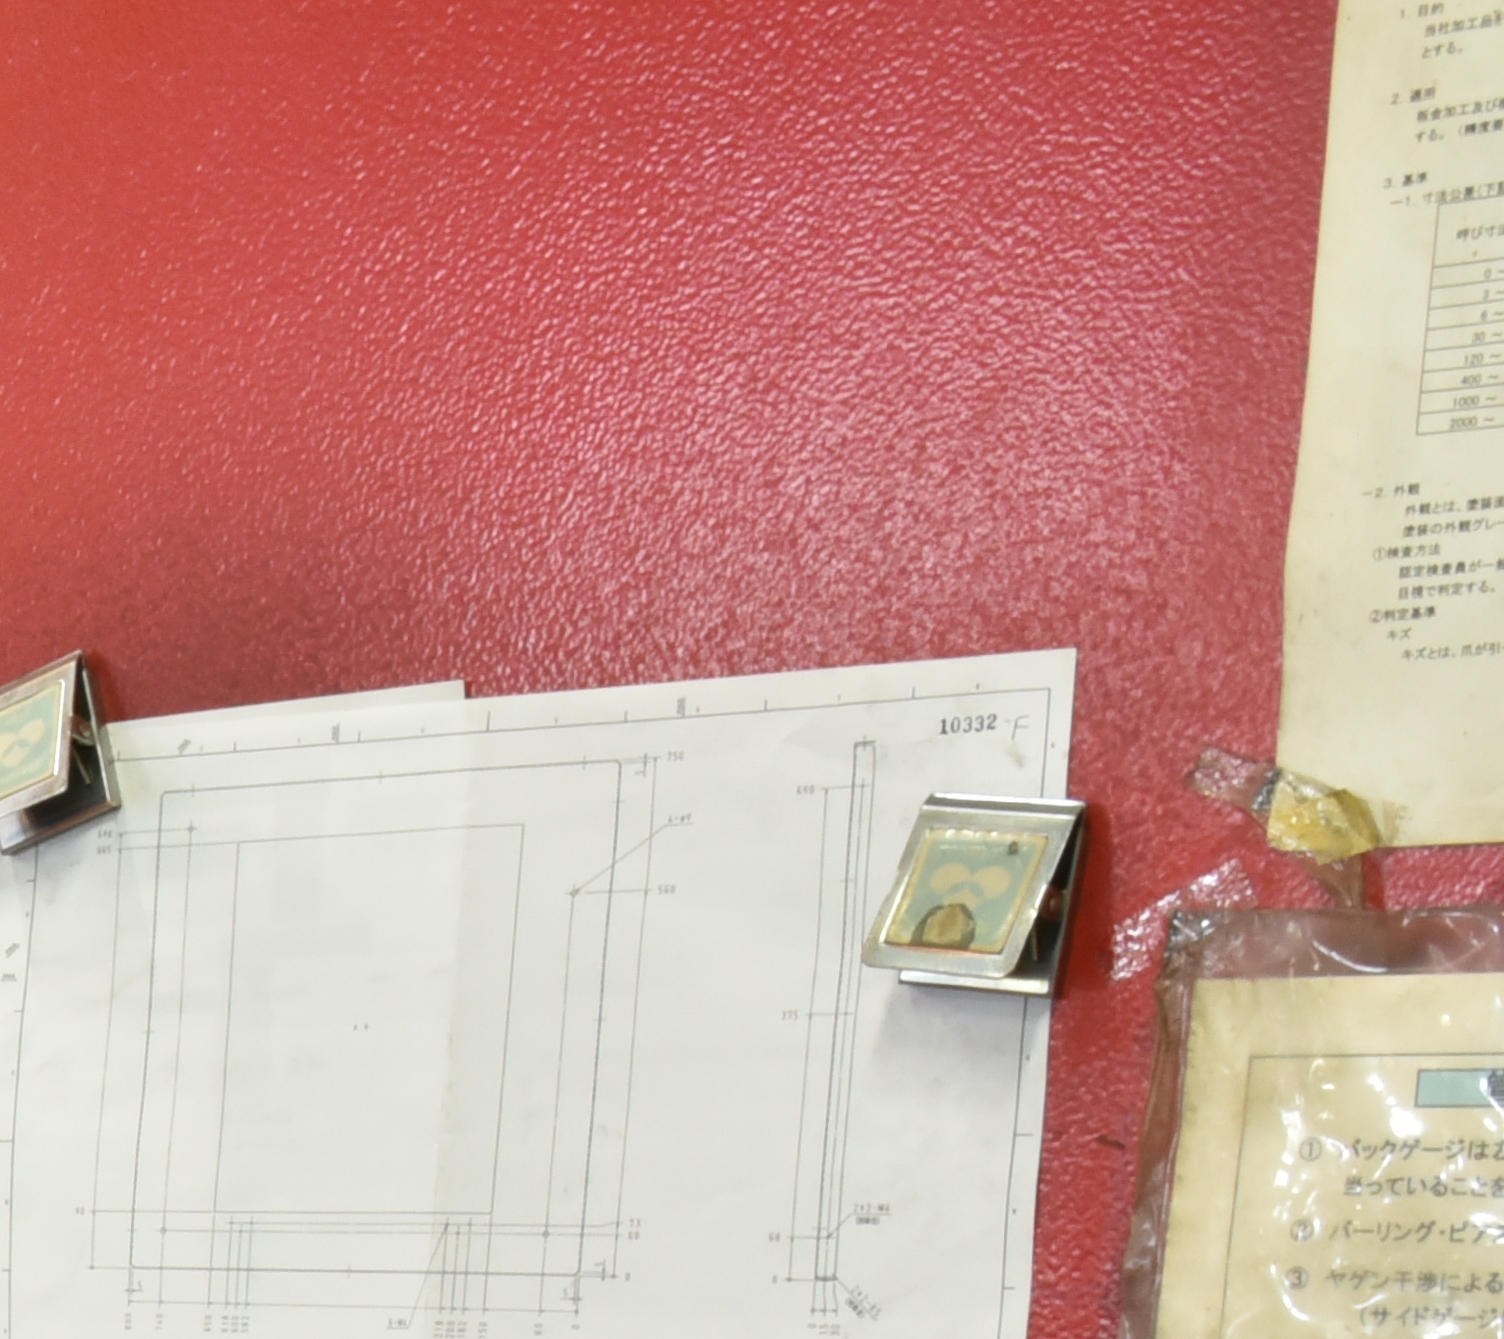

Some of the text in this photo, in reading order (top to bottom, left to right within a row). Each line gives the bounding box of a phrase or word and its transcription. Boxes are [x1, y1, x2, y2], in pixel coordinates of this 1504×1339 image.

[1462, 352, 1484, 366] 120
[1460, 373, 1482, 387] 400
[1452, 394, 1481, 409] 1000
[1449, 415, 1478, 431] 2000
[1386, 627, 1412, 641] キズ
[939, 713, 998, 736] 10332
[1285, 1265, 1309, 1290] ③
